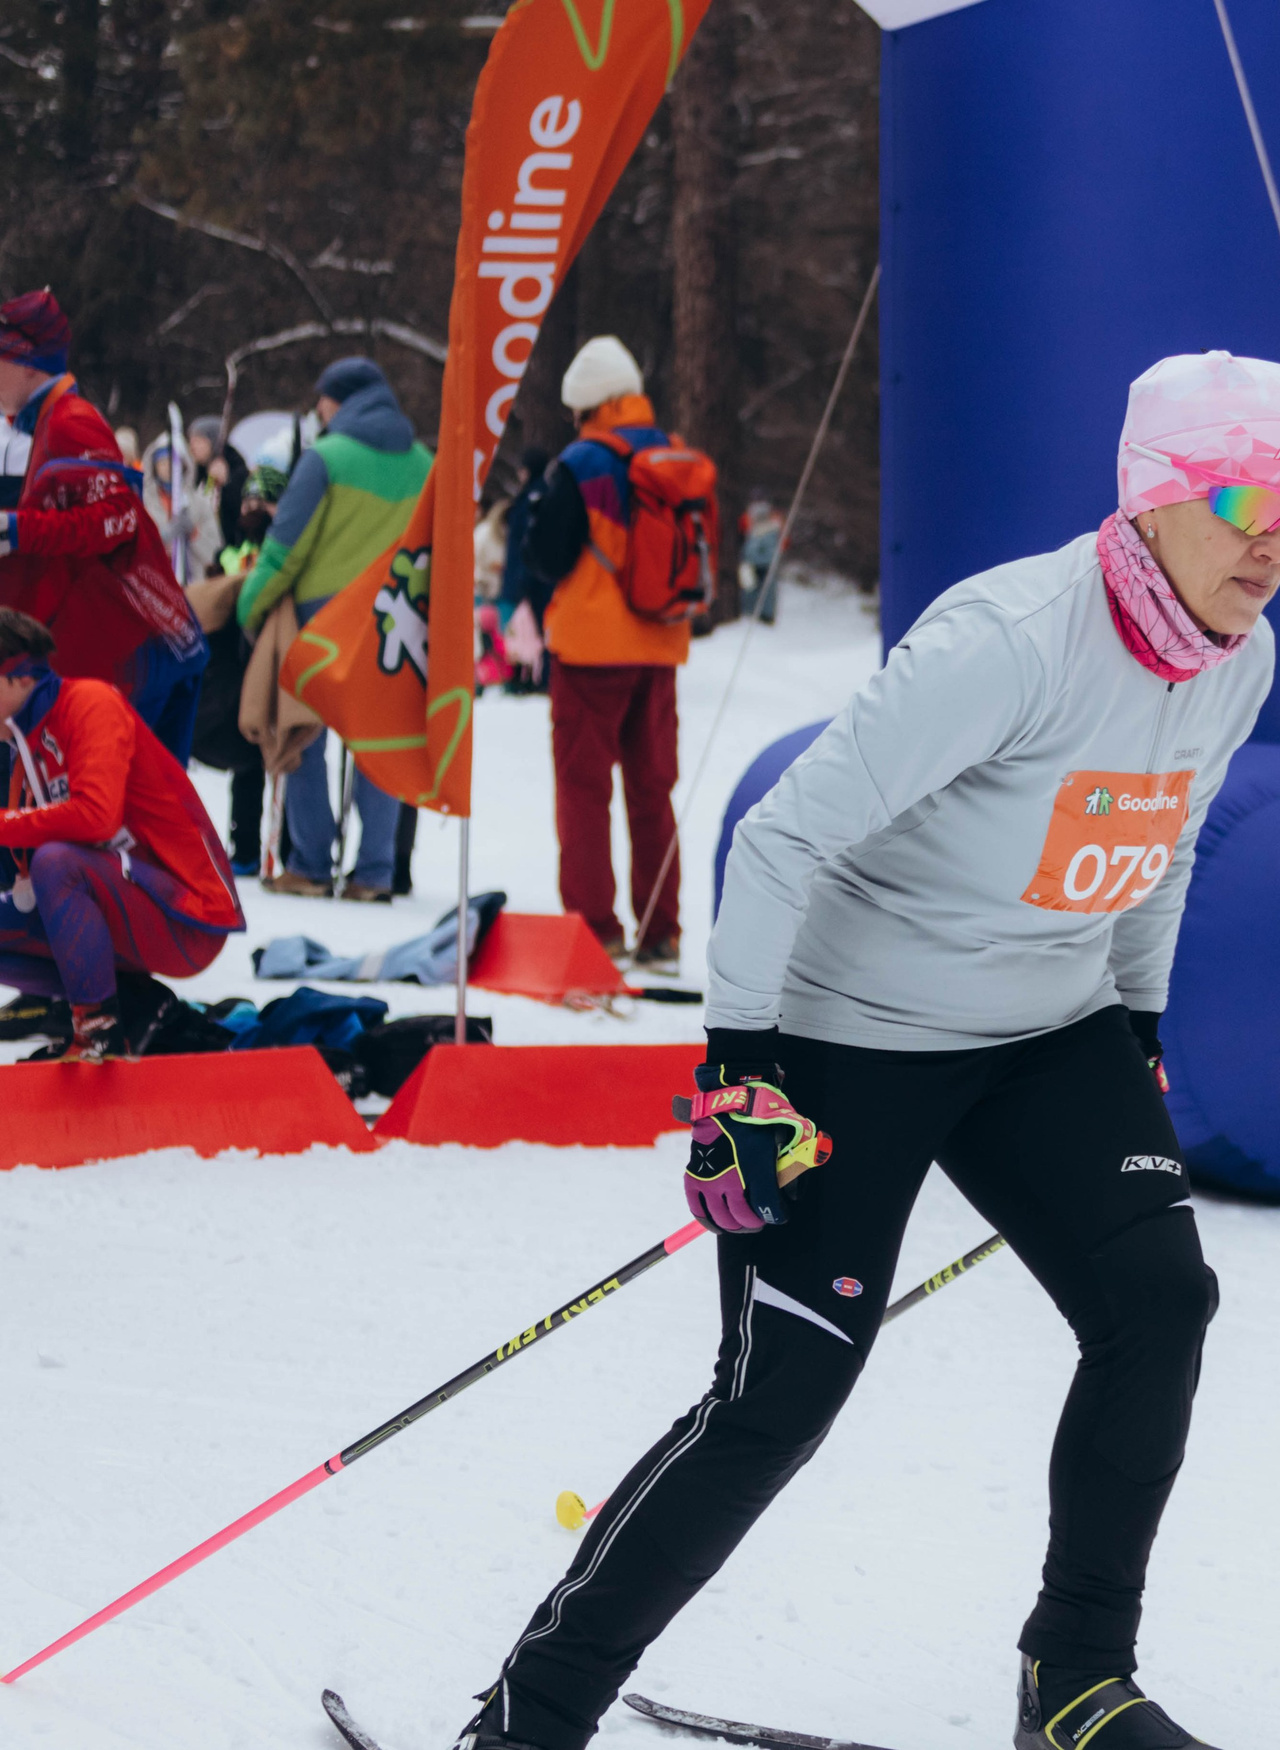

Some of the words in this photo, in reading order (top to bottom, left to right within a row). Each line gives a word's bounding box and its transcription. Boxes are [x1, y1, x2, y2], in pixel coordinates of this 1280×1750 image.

[1117, 790, 1178, 811] Goodne
[1063, 844, 1169, 901] 079
[711, 1090, 748, 1109] EKI
[1122, 1155, 1181, 1174] KV+
